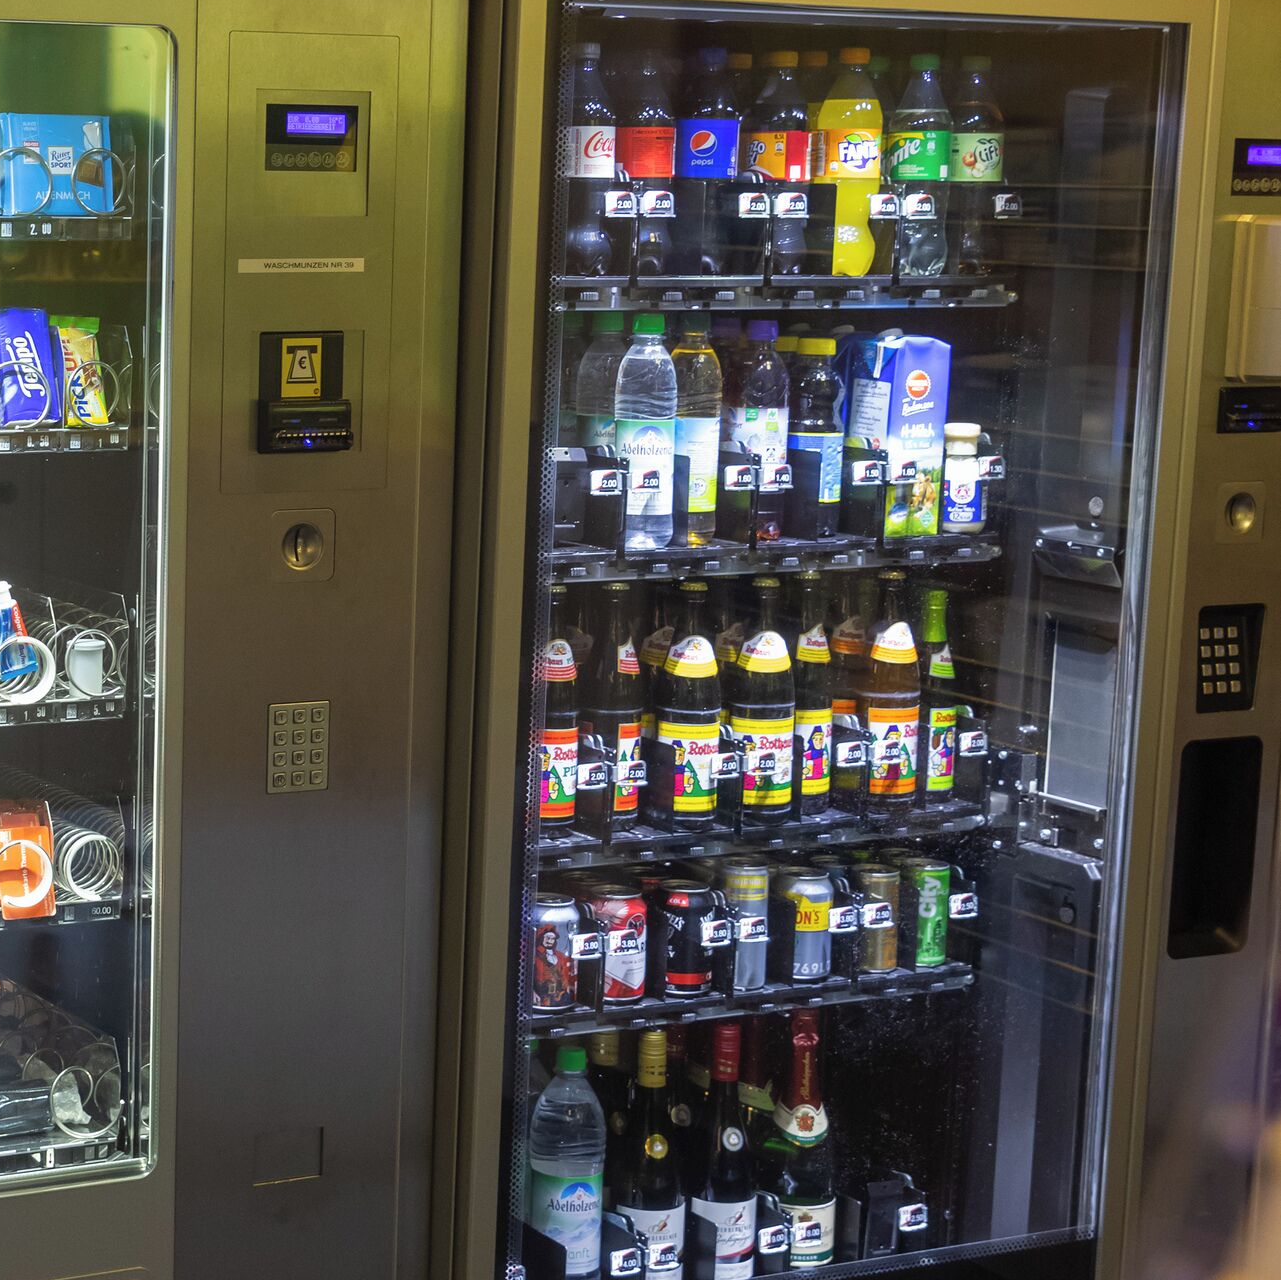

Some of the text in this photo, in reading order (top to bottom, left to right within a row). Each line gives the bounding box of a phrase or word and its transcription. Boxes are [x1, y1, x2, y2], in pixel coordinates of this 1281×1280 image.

[49, 150, 72, 161] Ritter
[50, 161, 72, 170] SPORT
[690, 158, 714, 168] pepsi
[617, 199, 632, 209] 2.00
[655, 199, 671, 209] 2.00
[750, 201, 765, 211] 2.00
[788, 201, 805, 210] 2.00
[880, 203, 896, 213] 2.00
[915, 202, 931, 211] 2.00
[1003, 202, 1019, 211] 2.00
[330, 261, 343, 269] NR
[11, 332, 47, 398] Tempo
[902, 468, 916, 477] 1.60
[989, 464, 1002, 473] 1.30
[775, 473, 789, 483] 1.40
[865, 469, 879, 478] 1.50
[602, 478, 617, 488] 2.00
[643, 477, 659, 487] 2.00
[737, 474, 753, 483] 1.60
[952, 512, 960, 520] 12
[971, 739, 985, 748] 2.00
[848, 750, 861, 759] 2.00
[885, 747, 899, 757] 2.00
[722, 761, 737, 771] 2.00
[760, 759, 775, 768] 2.00
[590, 771, 605, 781] 2.00
[629, 769, 644, 779] 2.00
[920, 875, 943, 918] City
[961, 901, 974, 910] 2.50
[91, 906, 112, 916] 60.00
[876, 910, 890, 919] 2.50
[840, 914, 853, 922] 3.80
[713, 929, 727, 938] 3.80
[751, 925, 764, 934] 3.80
[584, 941, 598, 950] 3.80
[622, 939, 636, 949] 3.80
[805, 1228, 819, 1237] 8.00
[623, 1258, 638, 1268] 4.00
